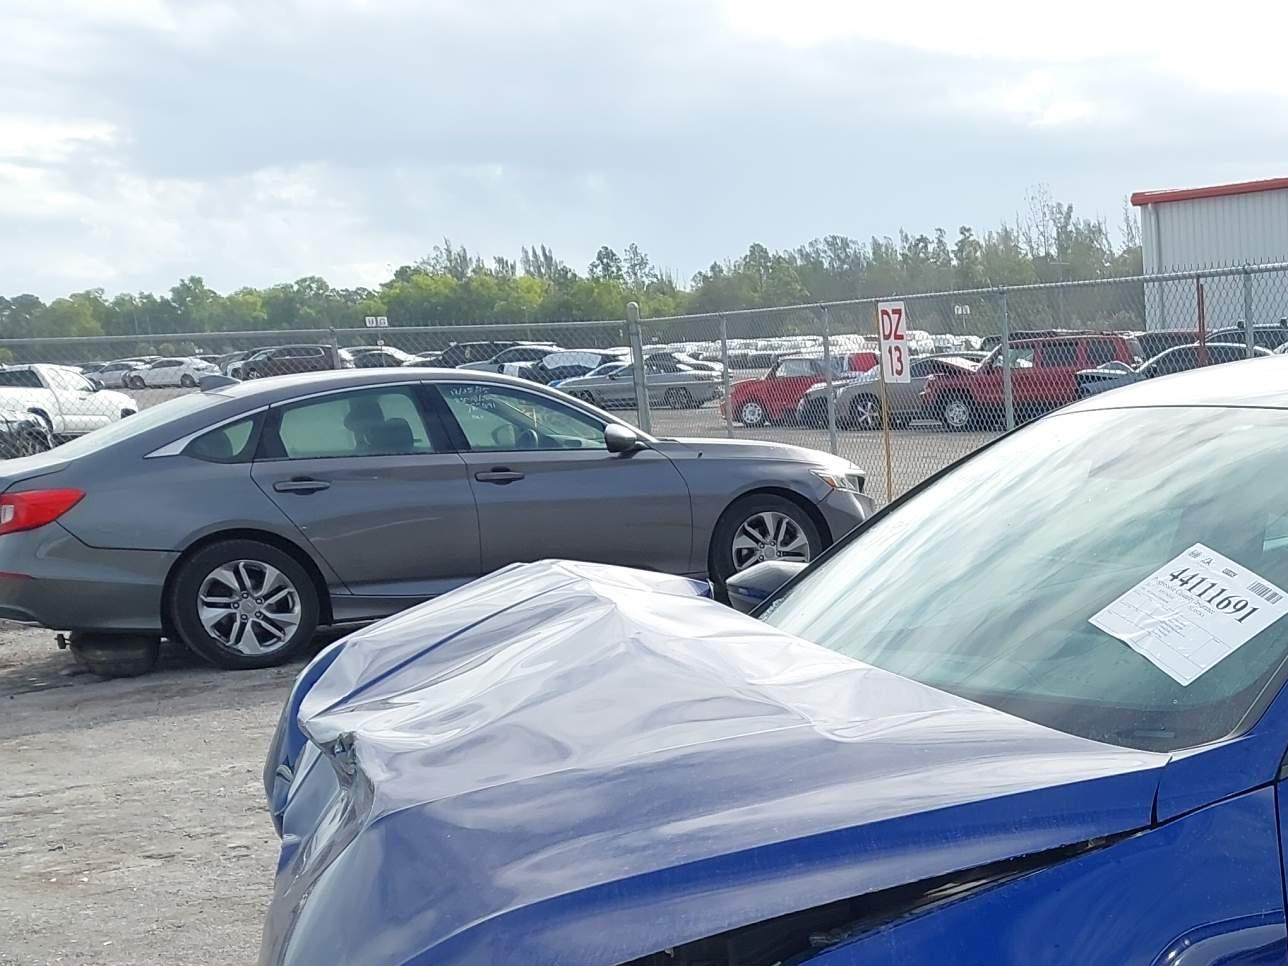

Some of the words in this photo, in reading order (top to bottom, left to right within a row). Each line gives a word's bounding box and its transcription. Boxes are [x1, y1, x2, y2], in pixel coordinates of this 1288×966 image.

[880, 308, 905, 341] DZ
[887, 345, 904, 377] 13
[1168, 567, 1260, 624] 44111691
